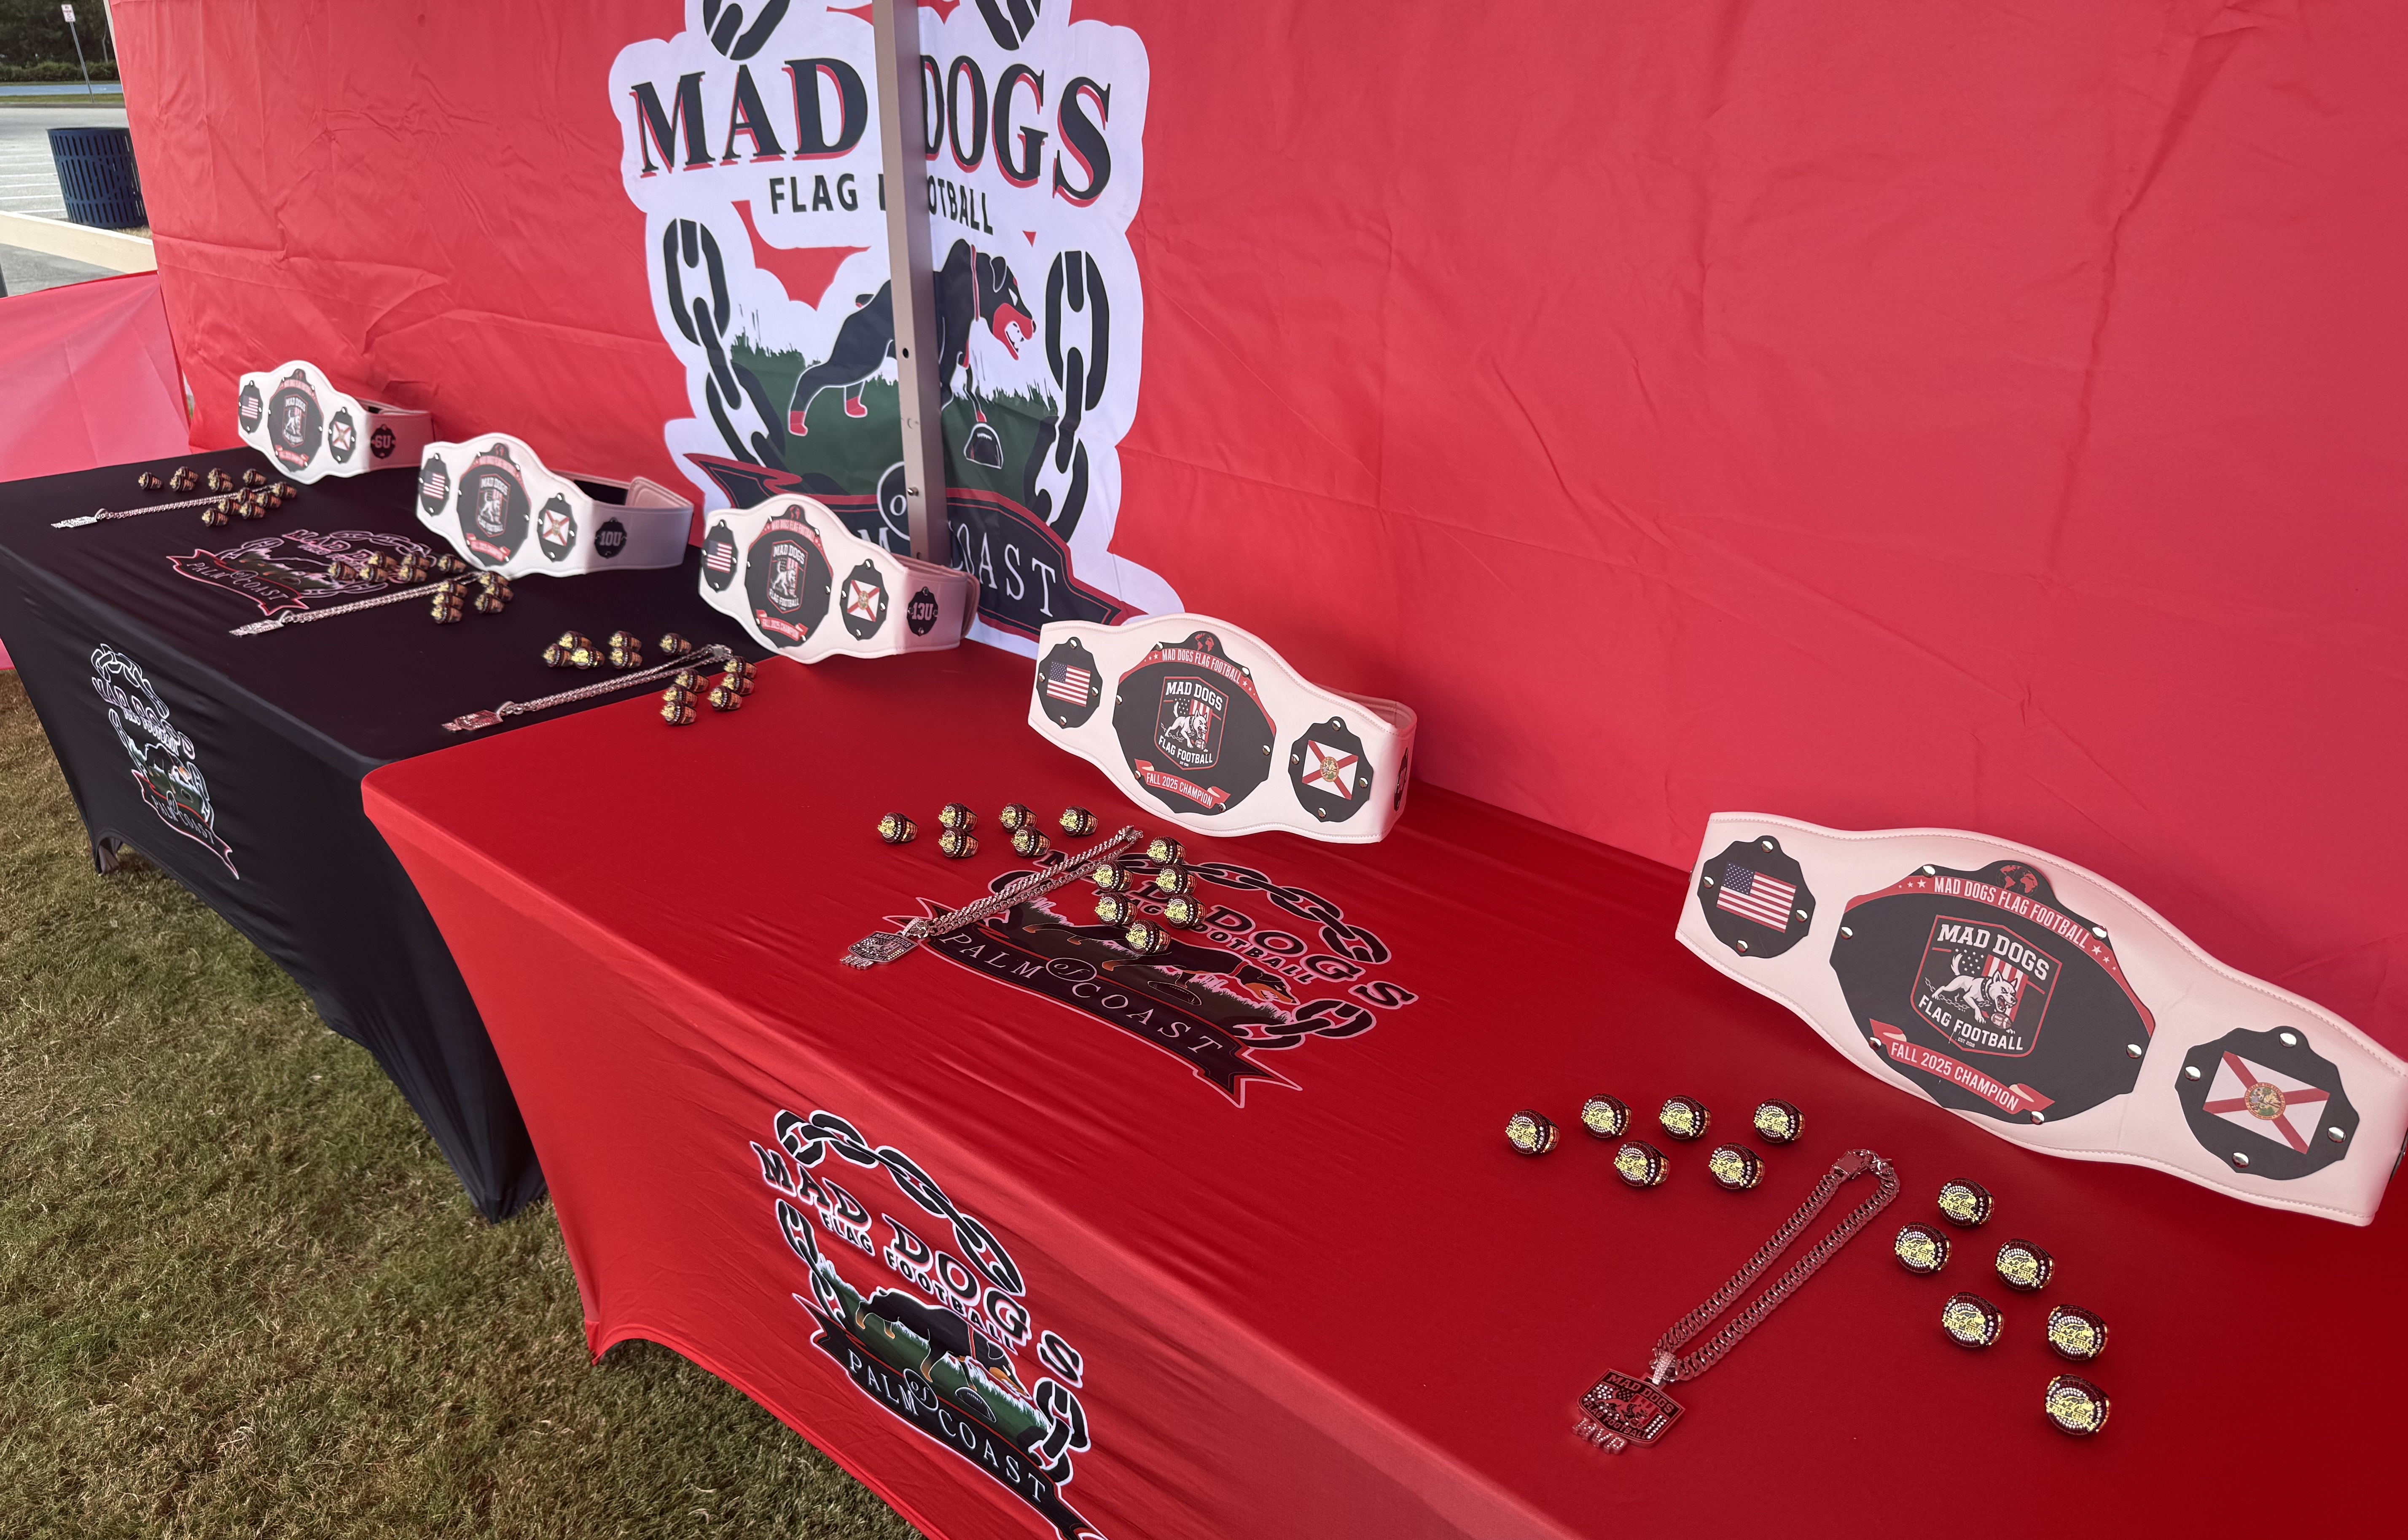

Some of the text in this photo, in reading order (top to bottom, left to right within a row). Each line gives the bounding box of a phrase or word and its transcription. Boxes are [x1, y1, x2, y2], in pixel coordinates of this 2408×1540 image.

[629, 55, 1112, 207] MAD DOGS
[769, 173, 993, 235] FLAG OTBALL
[375, 435, 392, 449] 6U
[599, 531, 623, 546] 10U
[773, 544, 805, 564] MAD DOGS
[187, 562, 231, 579] PALM
[233, 579, 289, 600] COAST
[912, 602, 934, 621] 13U
[1162, 649, 1242, 684] MAD DOGS FLAG FOOTBALL
[1166, 681, 1223, 711] MAD DOGS
[1158, 735, 1213, 764] FLAG FOOTBALL
[1146, 772, 1213, 807] FALL 2025 CHAMPION
[1934, 877, 2091, 949] MAD DOGS FLAG FOOTBALL
[894, 936, 912, 948] DOGS
[1189, 922, 1315, 984] OOTBALL
[1204, 906, 1417, 1009] DOGS
[1937, 924, 2050, 980] MAD DOGS
[941, 933, 1223, 1054] PALM of COAST
[1919, 994, 2023, 1051] FLAG FOOTBALL
[1891, 1042, 2019, 1111] FALL 2025 CHAMPION
[1958, 1206, 1972, 1215] COAST
[750, 1140, 1083, 1387] MAD DOGS
[820, 1209, 1018, 1355] FLAG FOOTBALL
[2000, 1264, 2013, 1273] PALM
[2018, 1270, 2033, 1279] COAST
[1965, 1326, 1980, 1336] COAST
[2053, 1333, 2067, 1343] PALM
[2073, 1340, 2090, 1349] COAST
[1606, 1374, 1674, 1413] MAD DOGS
[848, 1349, 919, 1416] PALM
[938, 1409, 1046, 1502] COAST
[1583, 1400, 1647, 1439] FLAG FOOTBALL
[2051, 1405, 2089, 1424] PALM COAST
[1572, 1416, 1628, 1454] MVP
